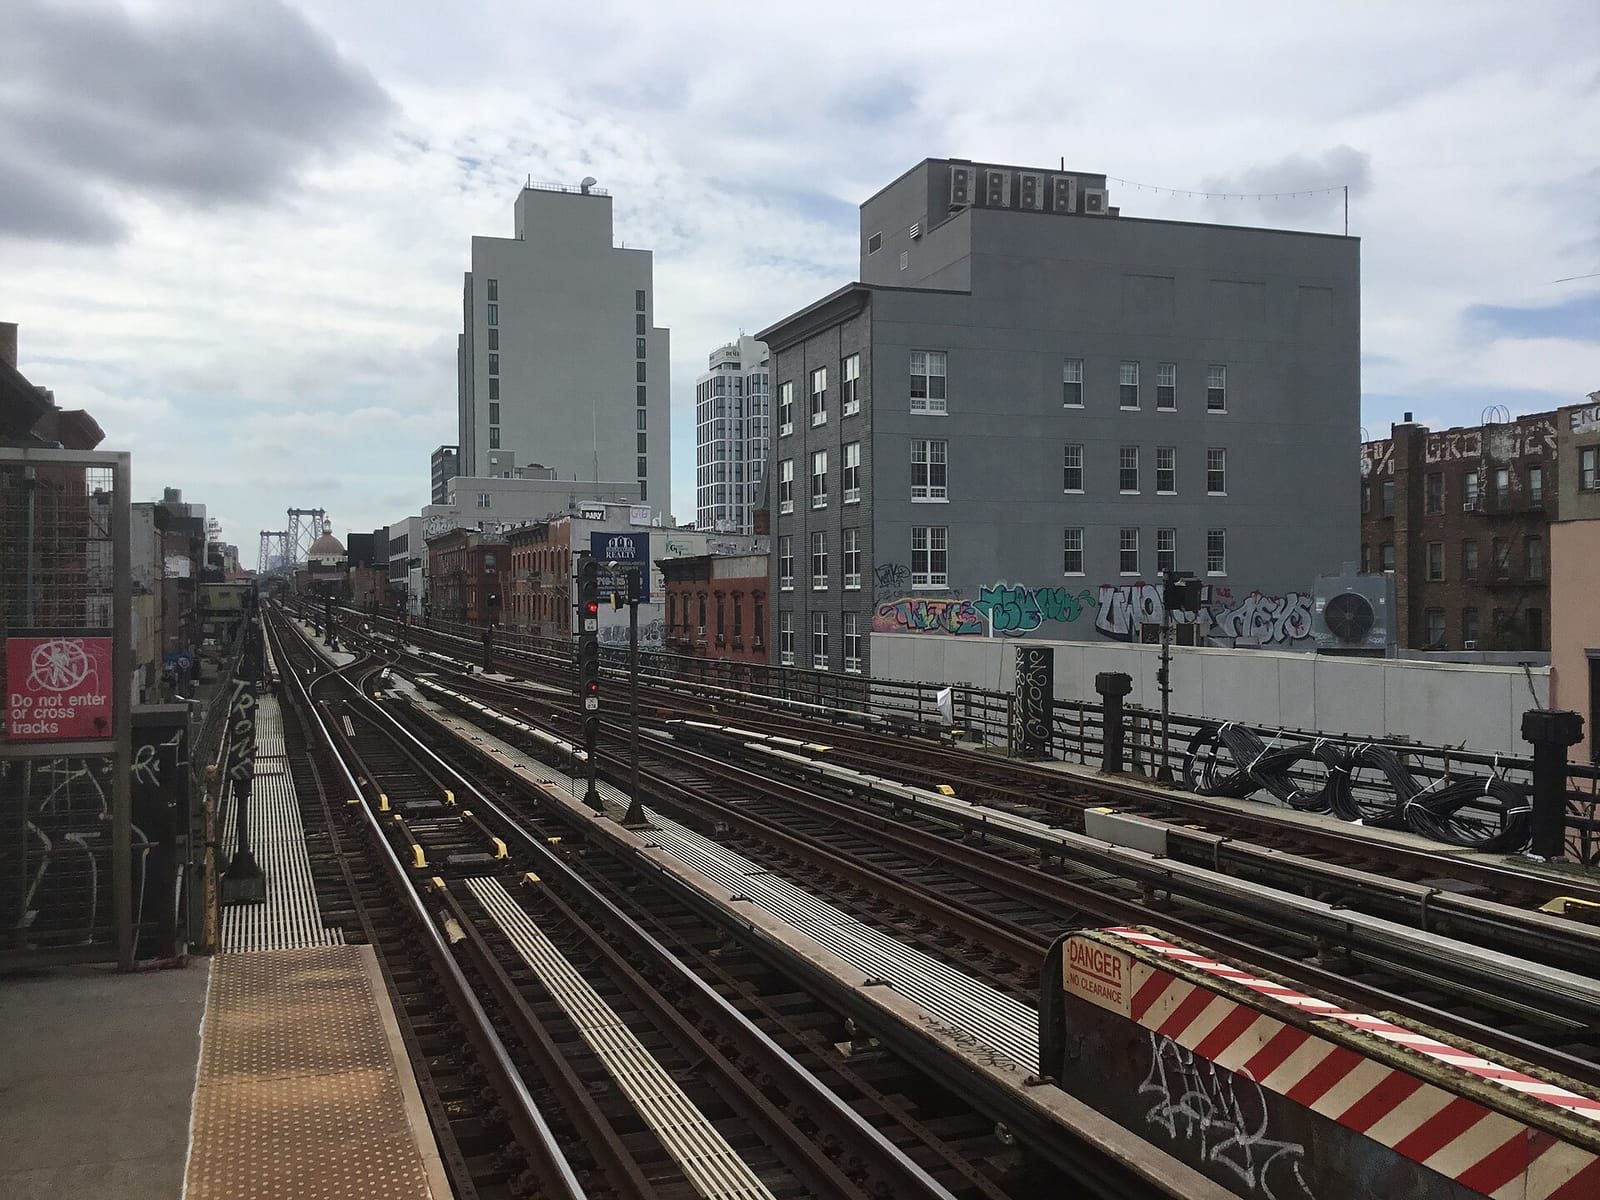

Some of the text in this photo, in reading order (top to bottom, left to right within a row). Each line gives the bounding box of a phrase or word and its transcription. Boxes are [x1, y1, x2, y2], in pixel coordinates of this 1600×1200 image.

[11, 692, 107, 708] Do not enter
[12, 707, 75, 720] or cross
[12, 720, 59, 734] tracks
[1070, 940, 1121, 980] DANGER
[1070, 973, 1122, 1005] NO CLEARANCE
